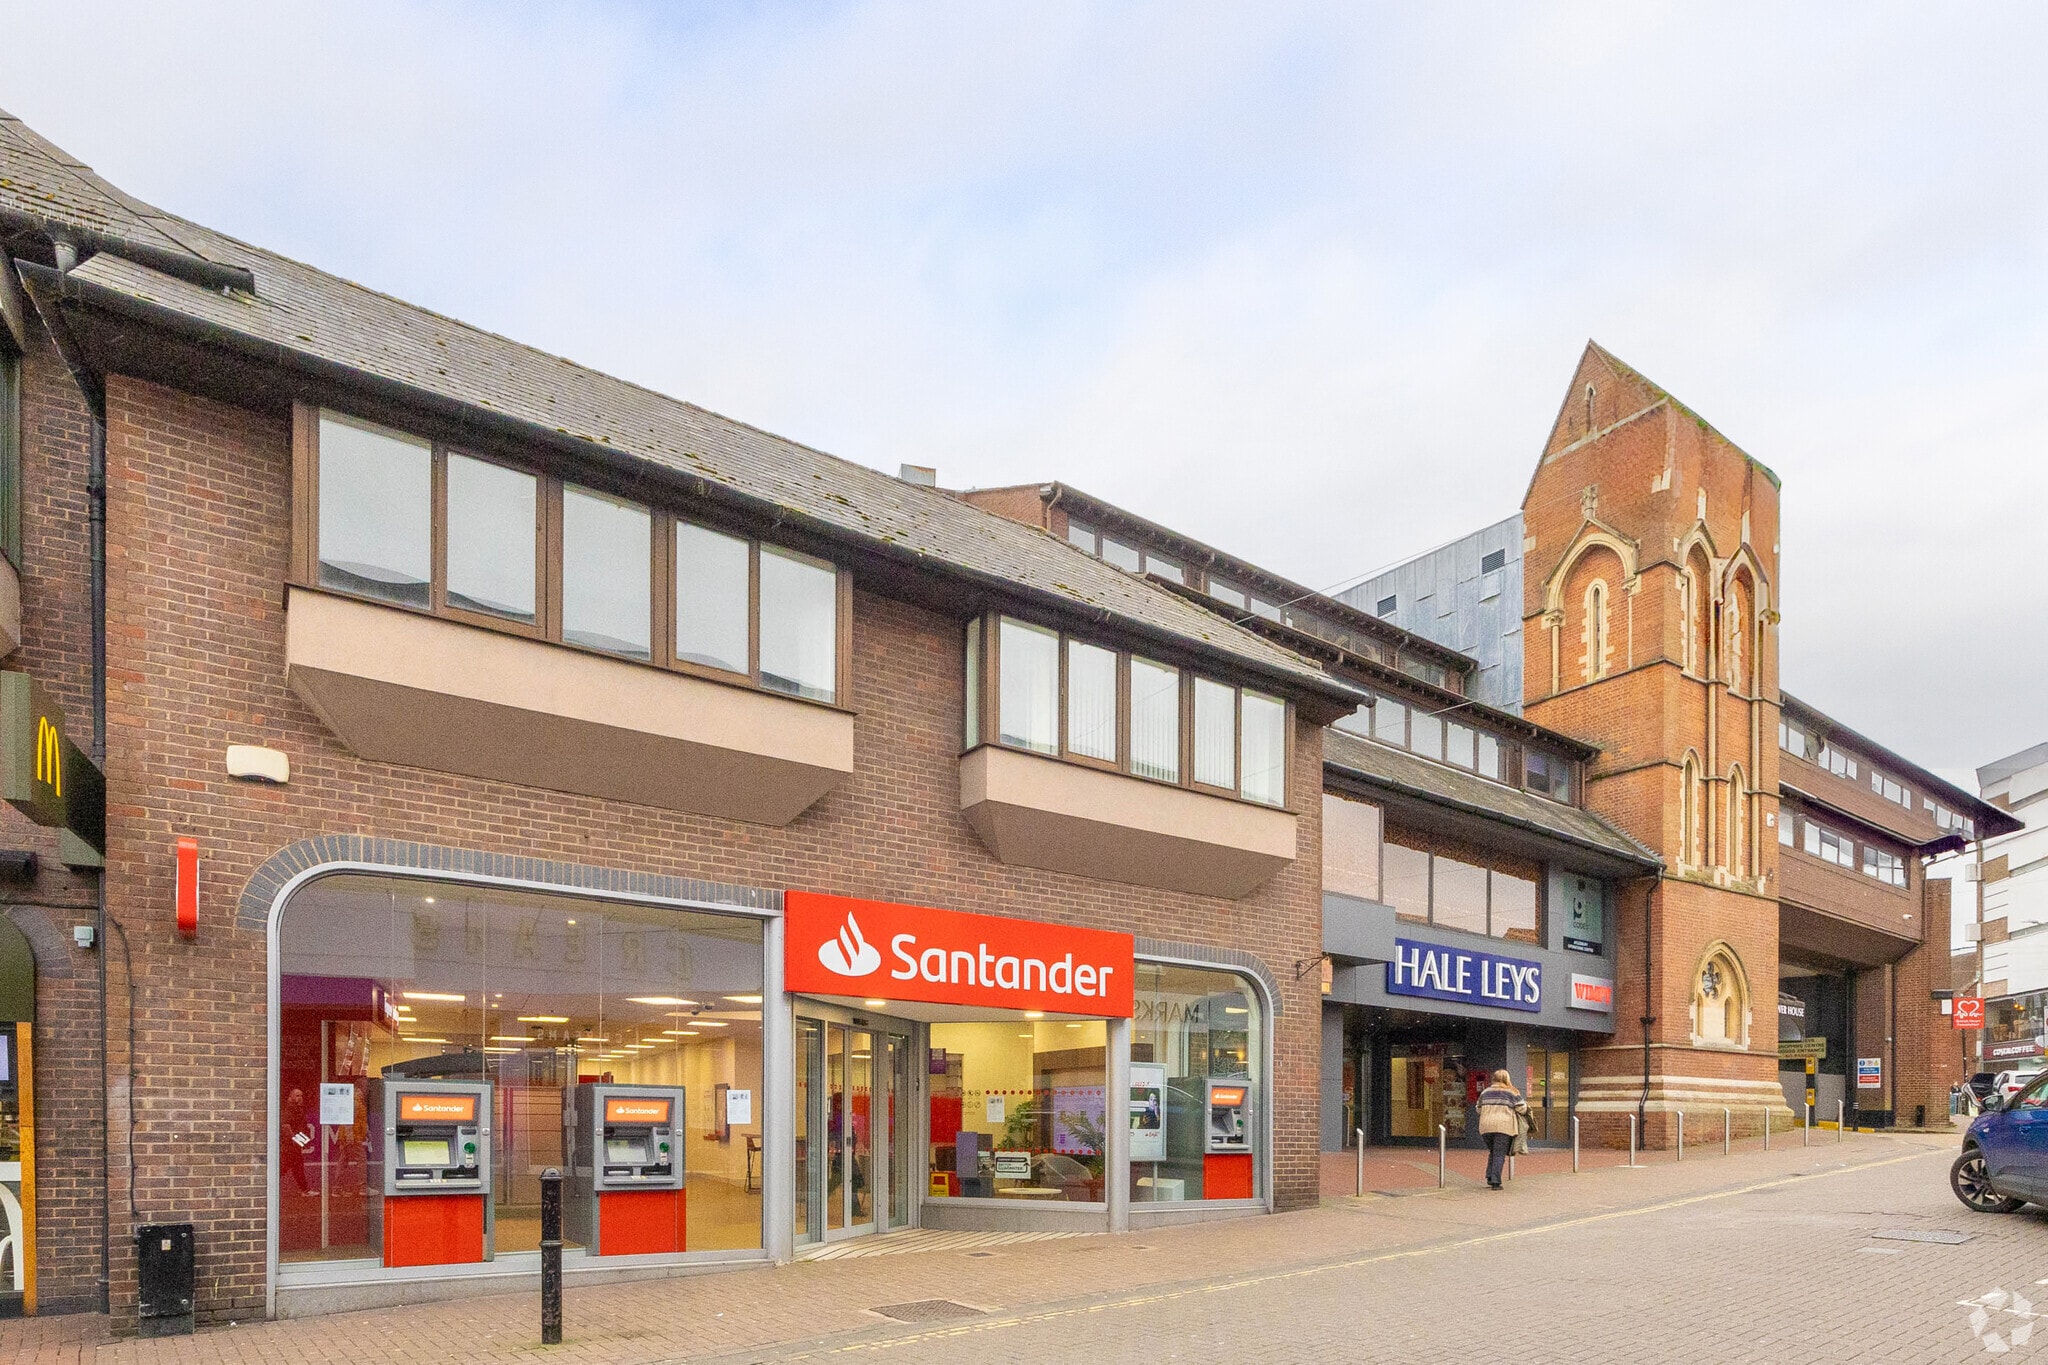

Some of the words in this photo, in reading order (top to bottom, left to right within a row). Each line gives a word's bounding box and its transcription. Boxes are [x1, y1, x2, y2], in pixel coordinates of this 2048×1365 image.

[891, 933, 1114, 997] Santander
[1395, 945, 1472, 994] HALE
[1481, 960, 1540, 1004] LEYS
[1574, 982, 1612, 1004] WIMPY
[1788, 1006, 1804, 1017] HOUSE
[2012, 1045, 2035, 1054] COFFEE
[423, 1104, 464, 1113] Santander
[625, 1107, 660, 1115] Santander
